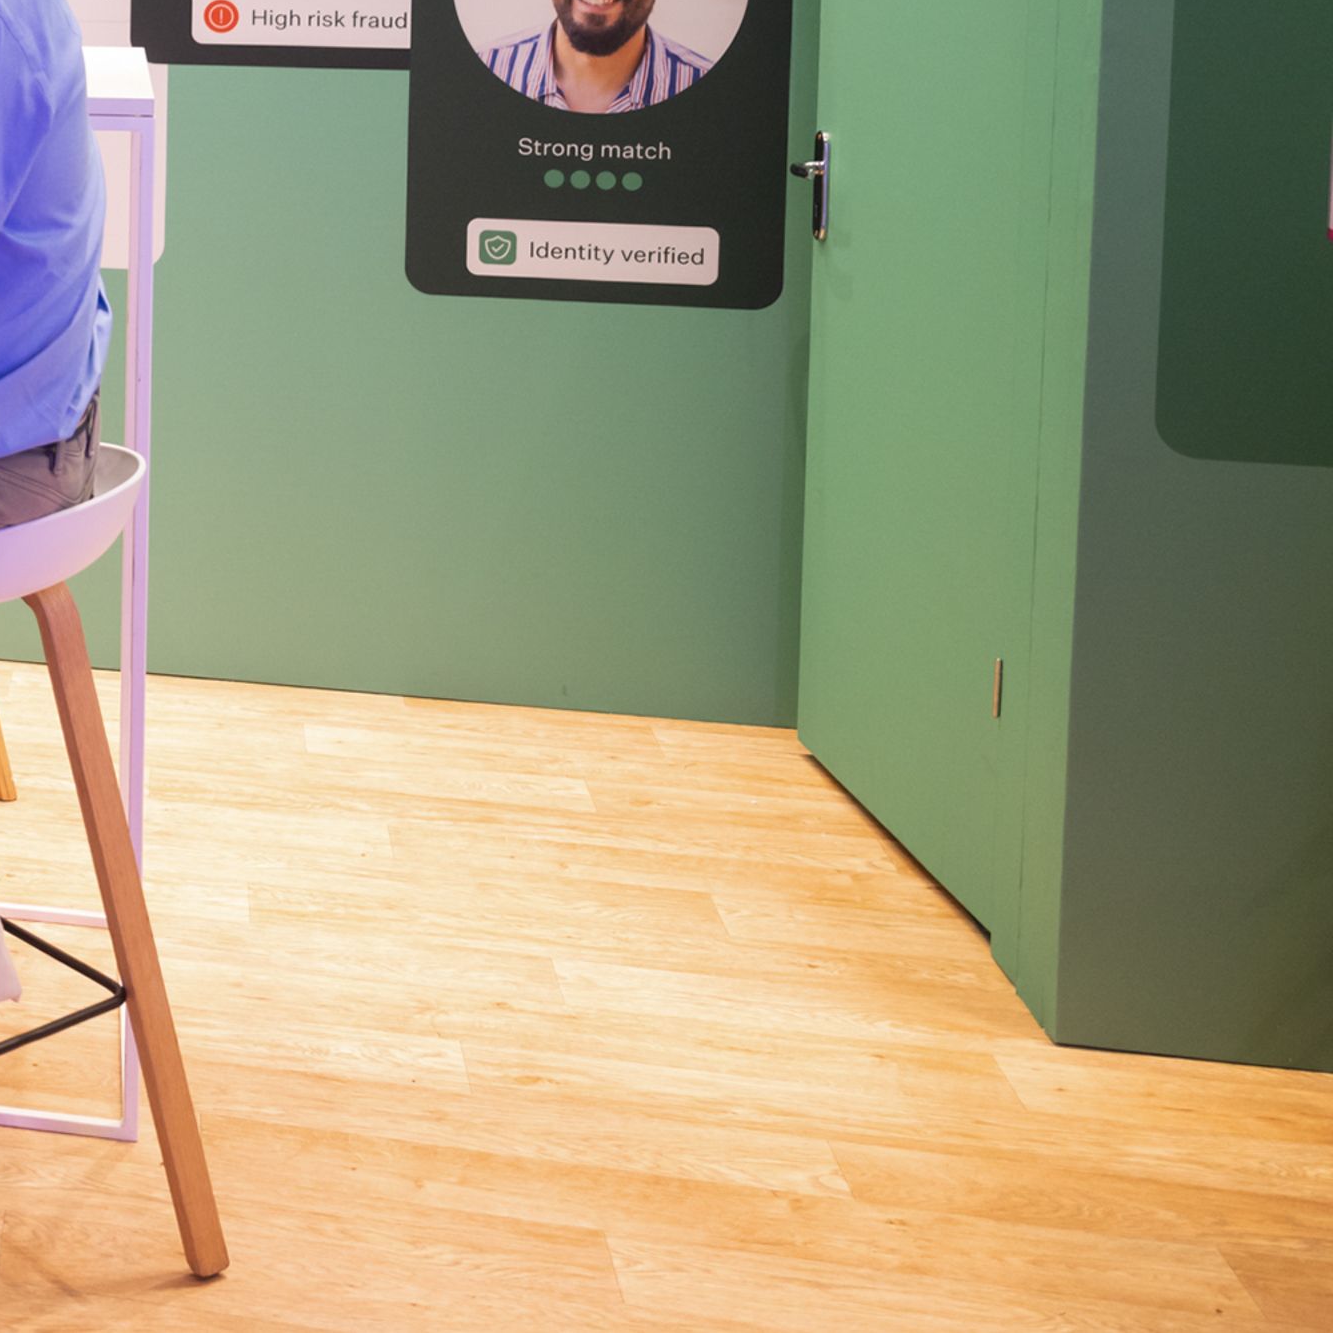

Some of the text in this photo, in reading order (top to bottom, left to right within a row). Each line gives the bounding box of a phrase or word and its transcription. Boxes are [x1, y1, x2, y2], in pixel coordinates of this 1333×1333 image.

[251, 9, 408, 31] High risk fraud
[518, 137, 672, 161] Strong match
[529, 240, 705, 266] Identity verified
